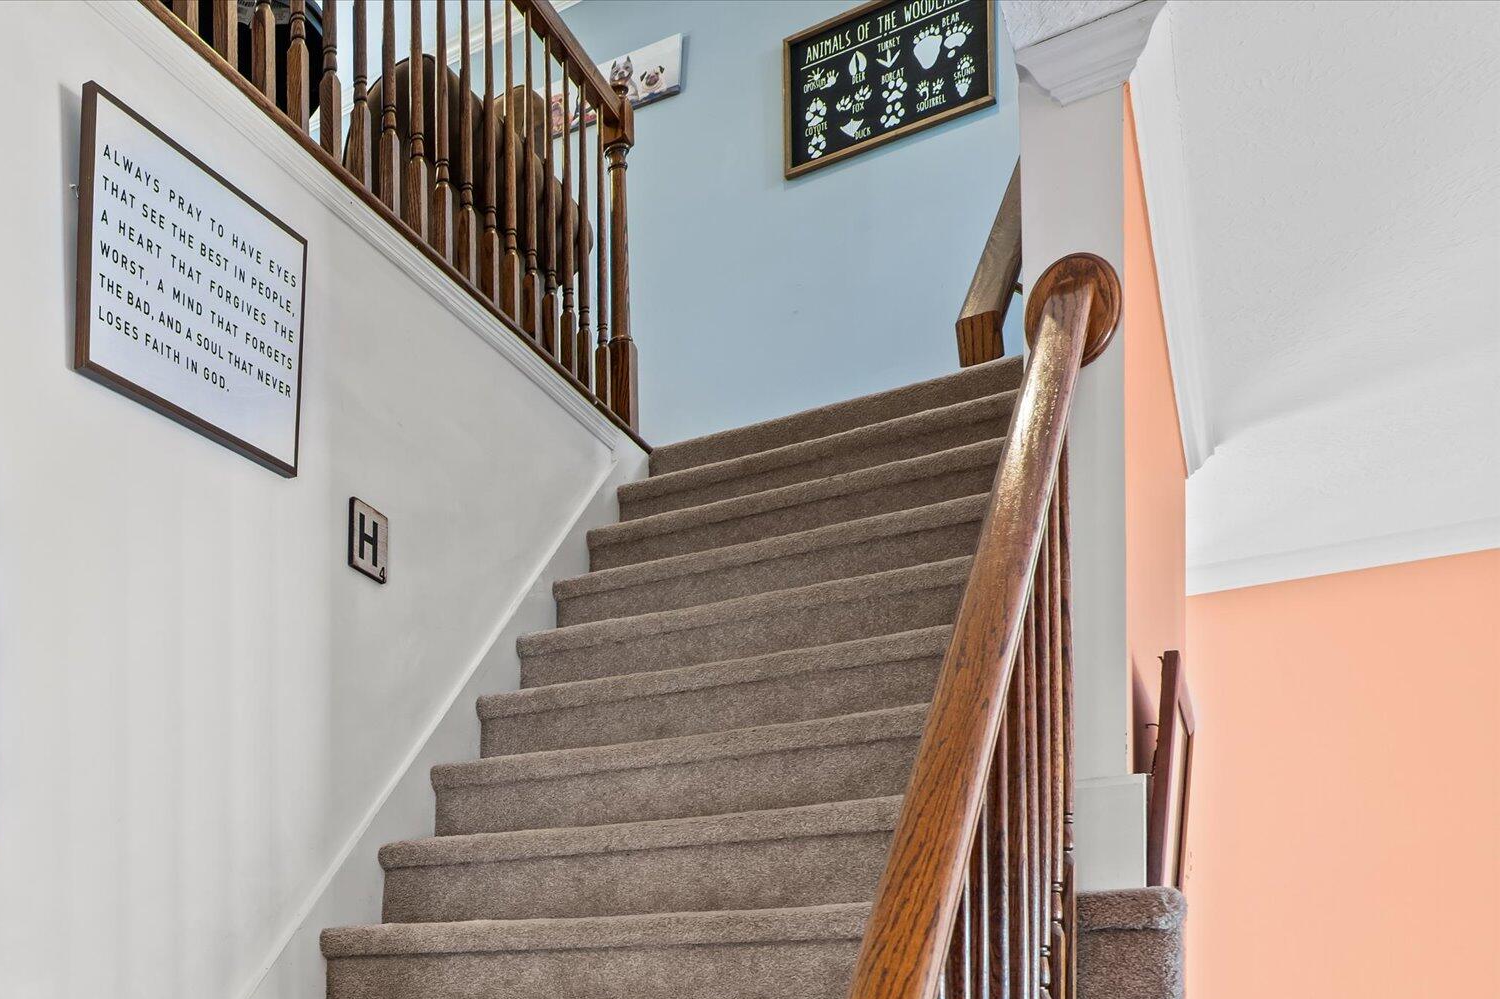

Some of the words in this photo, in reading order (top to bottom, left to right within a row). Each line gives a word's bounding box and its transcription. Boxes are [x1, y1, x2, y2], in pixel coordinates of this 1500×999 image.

[805, 30, 851, 64] ANIMALS
[857, 21, 871, 42] OF
[876, 10, 897, 34] THE
[903, 0, 958, 23] WOODL
[941, 11, 960, 28] BEAR
[877, 35, 901, 53] TURKEY
[851, 71, 866, 85] DEER
[881, 67, 905, 85] BOBCAT
[852, 101, 865, 114] FOX
[916, 93, 947, 113] SQUIRREL
[805, 121, 828, 137] COYOTE
[103, 144, 160, 193] ALWAYS
[169, 189, 201, 222] PRAY
[210, 217, 224, 238] TO
[232, 233, 262, 265] HAVE
[269, 259, 296, 288] EYES
[102, 175, 136, 208] THAT
[142, 203, 165, 230] SEE
[171, 222, 194, 249] THE
[200, 242, 229, 271] BEST
[234, 265, 245, 283] IN
[251, 276, 295, 317] PEOPLE,
[101, 209, 108, 225] A
[118, 219, 162, 259] HEART
[170, 254, 202, 284] THAT
[209, 279, 266, 326] FORGIVES
[273, 320, 294, 343] THE
[100, 240, 149, 286] WORST,
[157, 278, 164, 293] A
[172, 286, 203, 316] MIND
[210, 310, 238, 338] THAT
[245, 332, 292, 370] FORGETS
[98, 305, 139, 341] LOSES
[144, 333, 180, 365] FAITH
[186, 356, 198, 375] IN
[203, 366, 230, 392] GOD.
[99, 272, 122, 300] THE
[127, 290, 154, 321] BAD,
[158, 310, 182, 334] AND
[185, 327, 192, 342] A
[196, 333, 224, 360] SOUL
[227, 350, 253, 376] THAT
[257, 368, 291, 398] NEVER
[359, 511, 378, 568] H
[379, 566, 386, 584] 4
